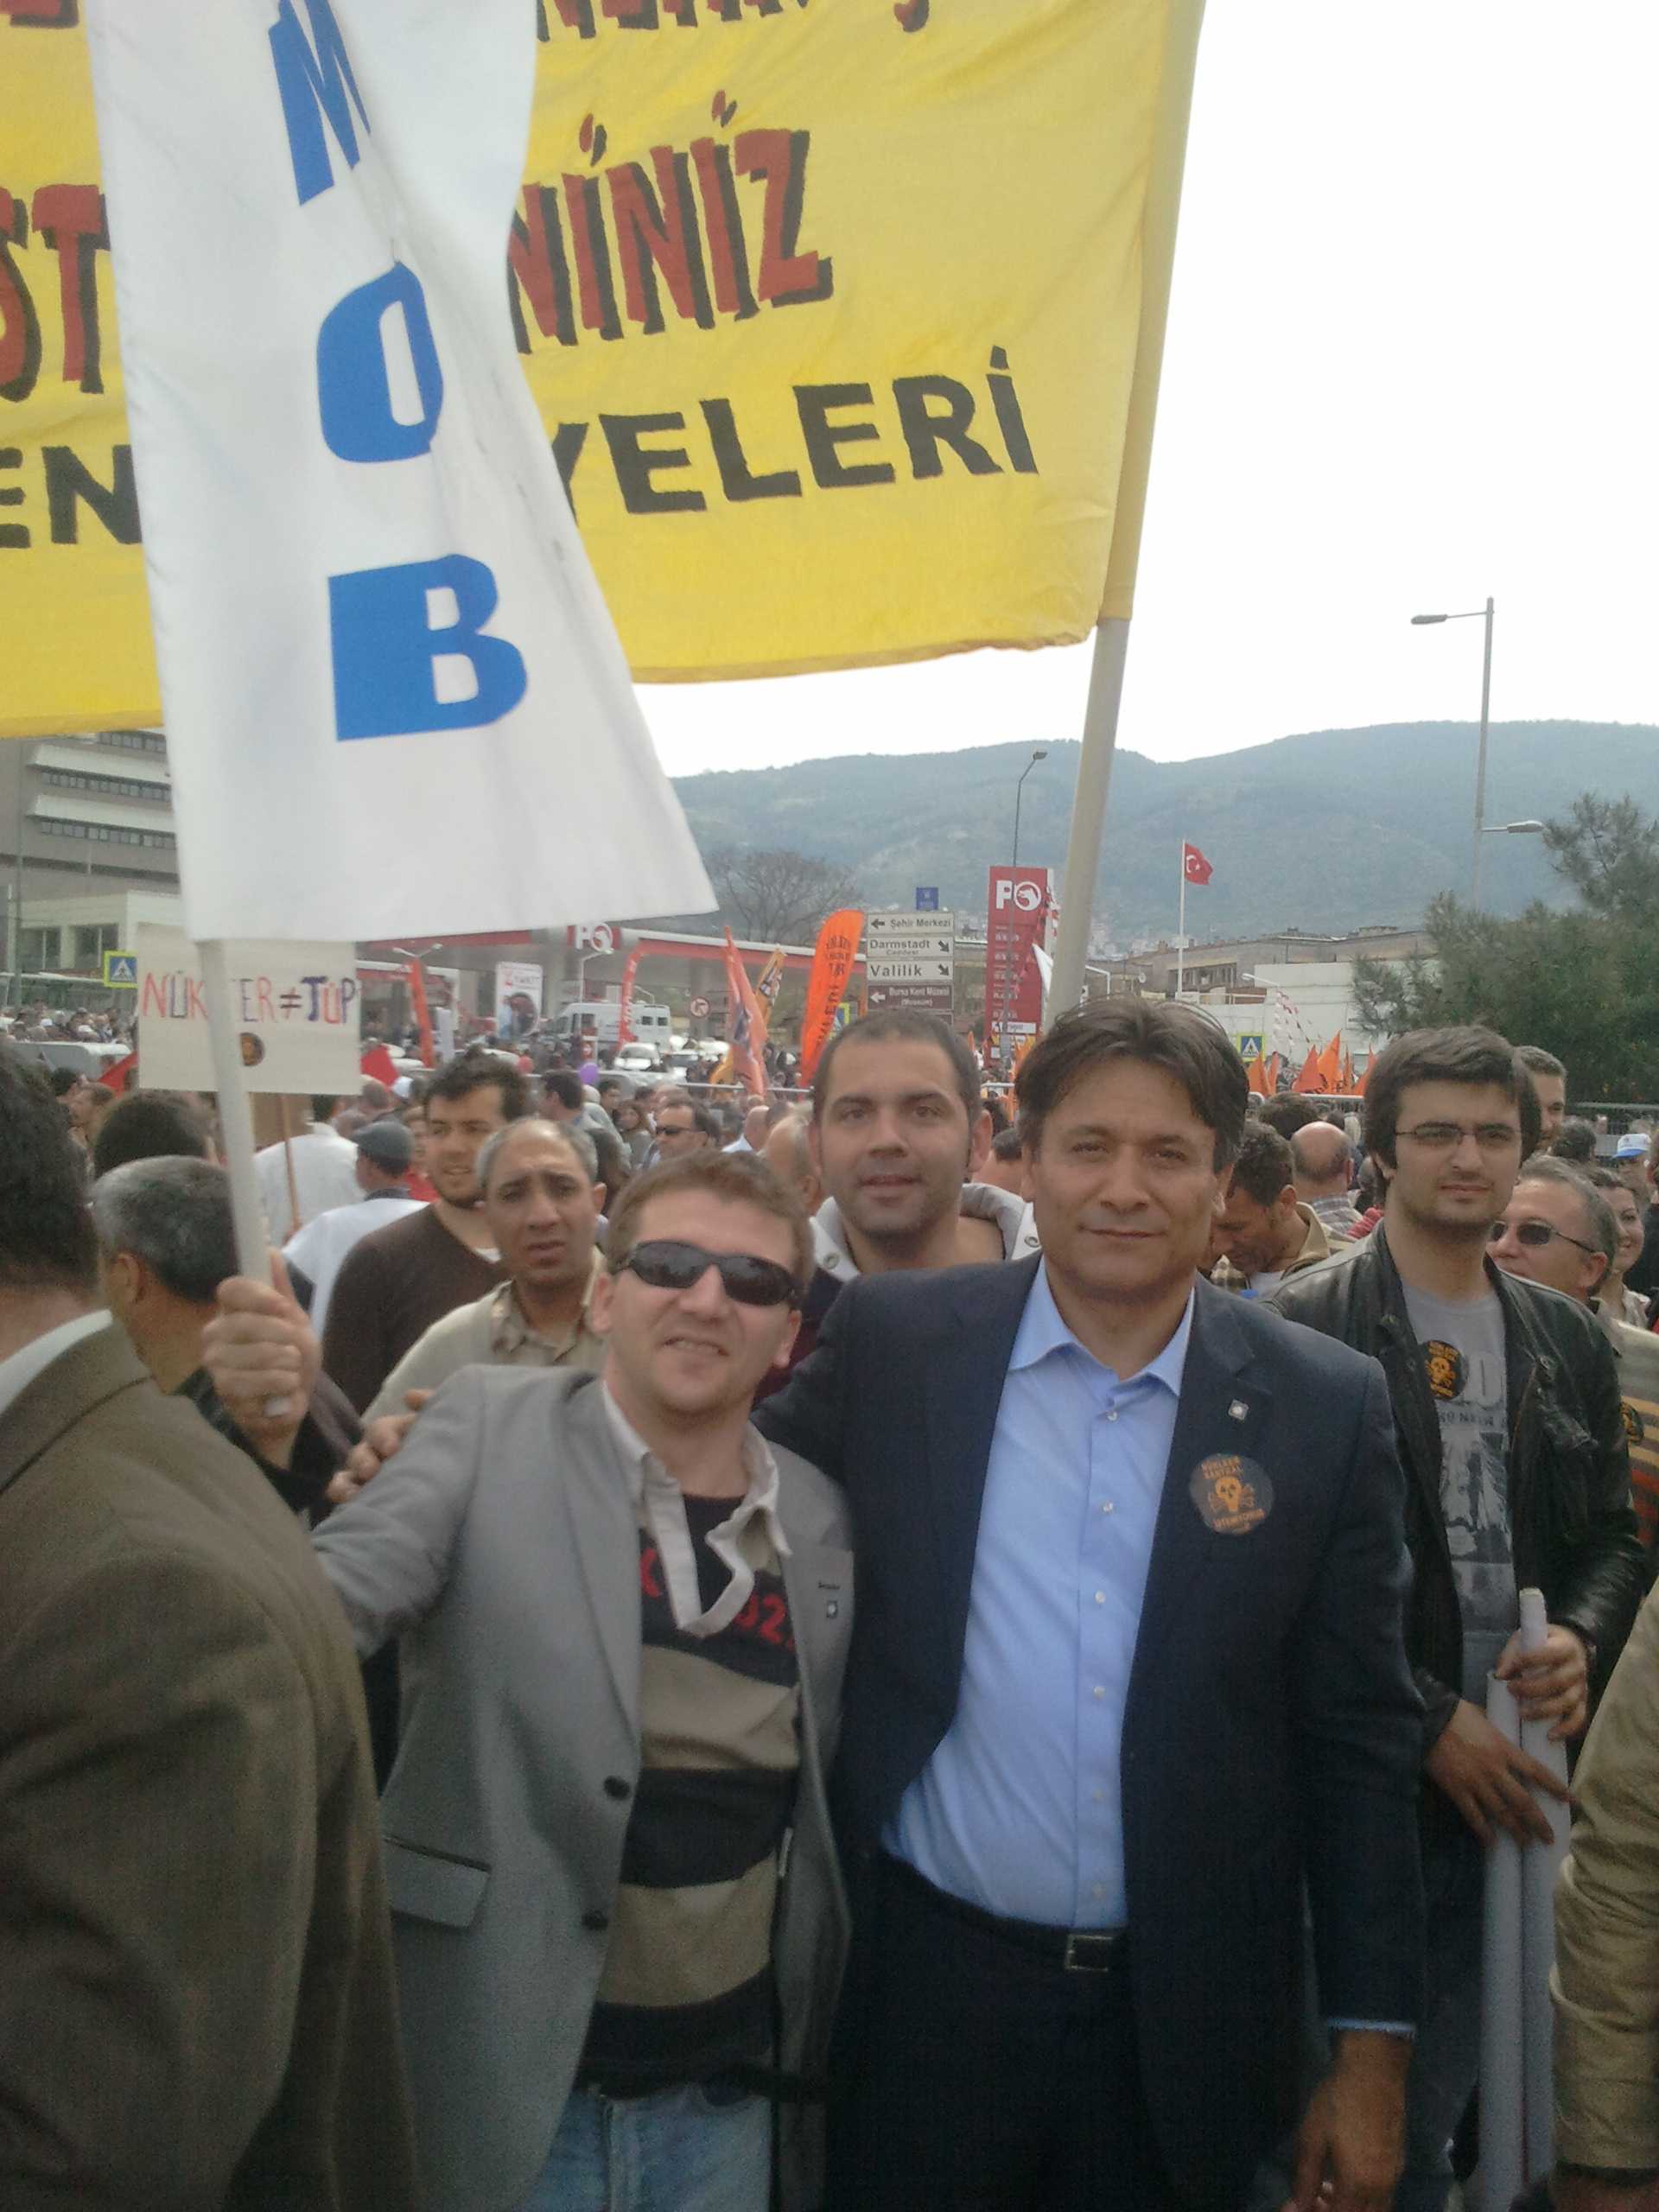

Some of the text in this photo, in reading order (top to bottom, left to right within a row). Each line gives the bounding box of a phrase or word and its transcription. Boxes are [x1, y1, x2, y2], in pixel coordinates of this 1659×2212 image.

[916, 918, 950, 927] Merkezi
[869, 939, 931, 949] Darmstadt
[870, 963, 922, 976] Valilik
